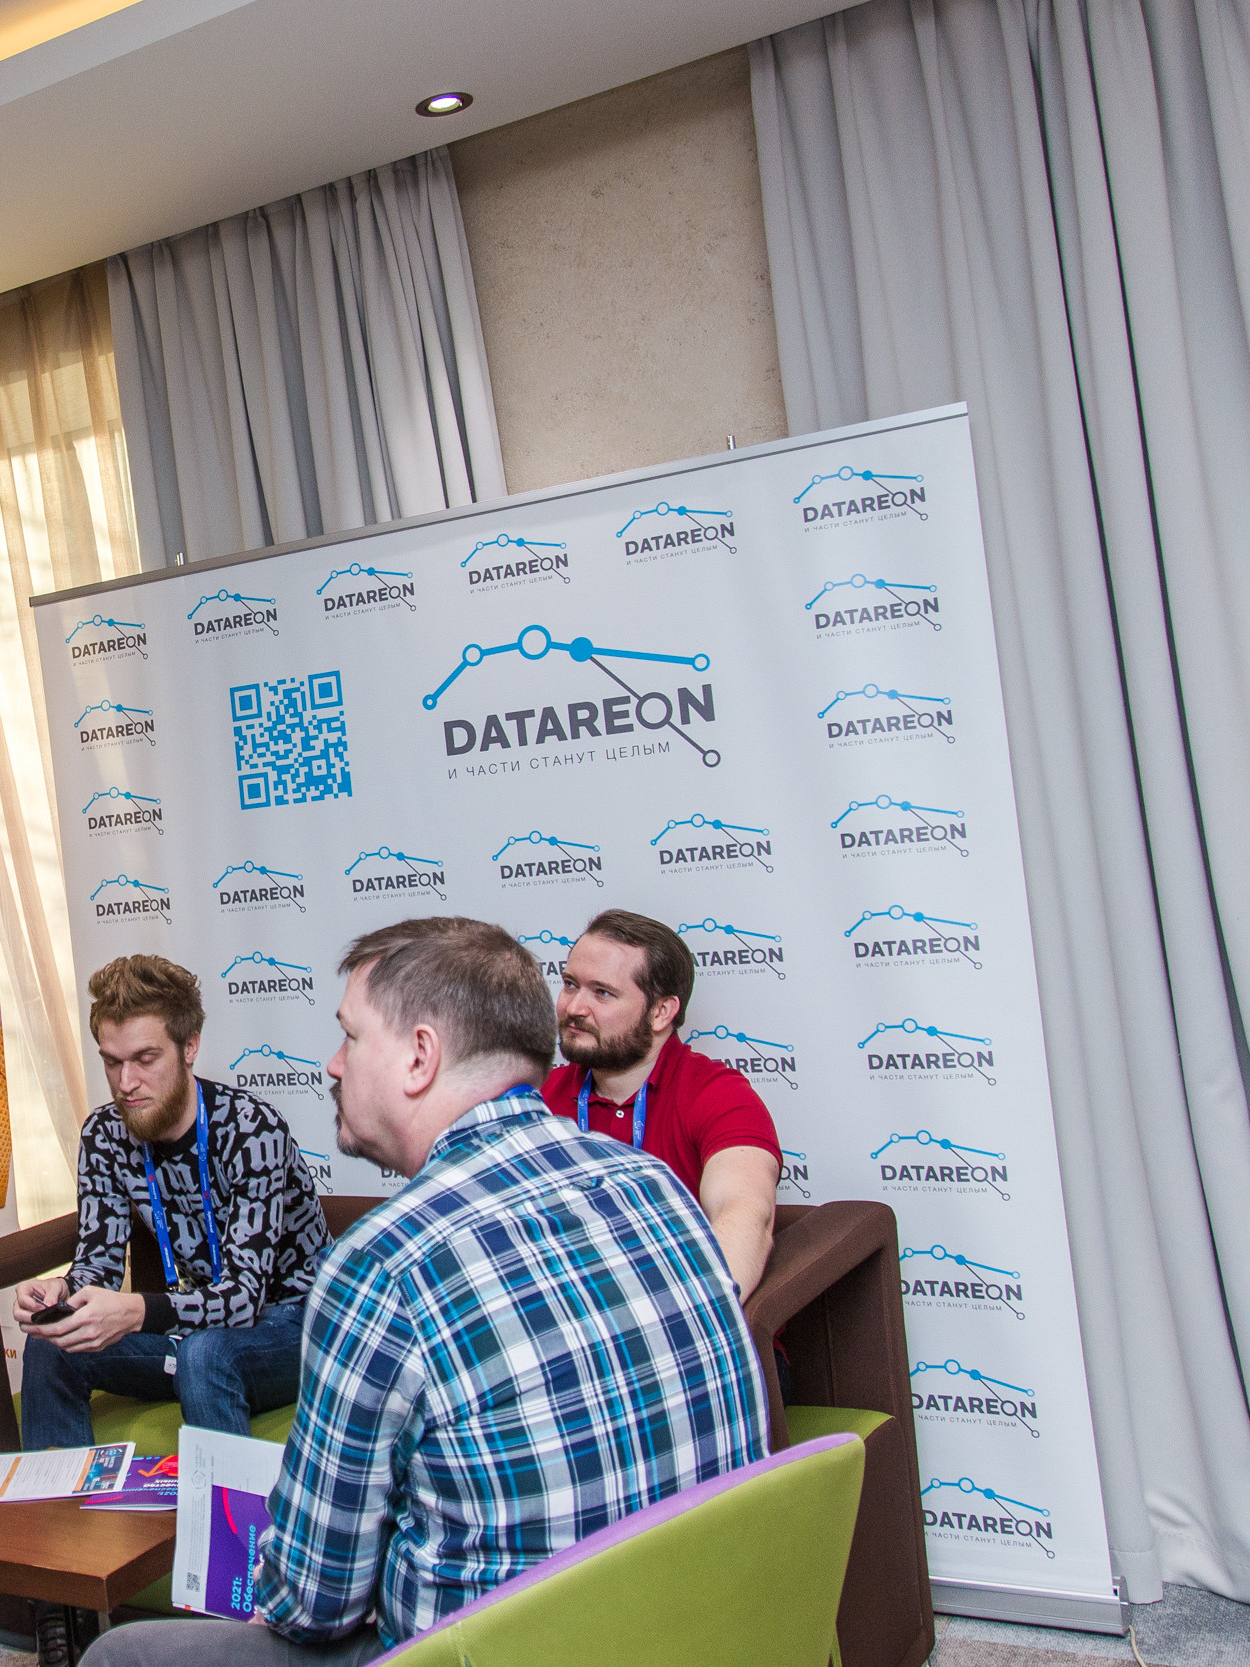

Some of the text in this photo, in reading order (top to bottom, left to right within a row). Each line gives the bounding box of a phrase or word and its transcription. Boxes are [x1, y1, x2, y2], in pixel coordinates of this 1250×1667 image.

[803, 487, 925, 523] DATAREON
[625, 522, 734, 555] DATAREON
[468, 553, 568, 584] DATAREON
[324, 582, 414, 611] DATAREON
[194, 608, 277, 635] DATAREON
[815, 597, 939, 629] DATAREON
[72, 633, 146, 658] DATAREON
[80, 719, 154, 743] DATAREON
[444, 684, 715, 756] DATAREON
[827, 710, 953, 738] DATAREON
[448, 741, 670, 779] И ЧАСТИ СТАНУТ ЦЕЛЫМ
[88, 808, 162, 829] DATAREON
[840, 823, 966, 848] DATAREON
[659, 840, 771, 864] DATAREON
[500, 856, 601, 879] DATAREON
[220, 884, 304, 904] DATAREON
[352, 871, 444, 892] DATAREON
[96, 898, 169, 916] DATAREON
[853, 935, 980, 957] DATAREON
[228, 977, 312, 994] DATAREON
[867, 1051, 994, 1069] DATAREON
[237, 1072, 322, 1086] DATAREON
[881, 1165, 1007, 1182] DATAREON
[923, 1509, 1052, 1539] DATAREON
[242, 1524, 257, 1612] Обеспечение
[231, 1576, 243, 1611] 2021:
